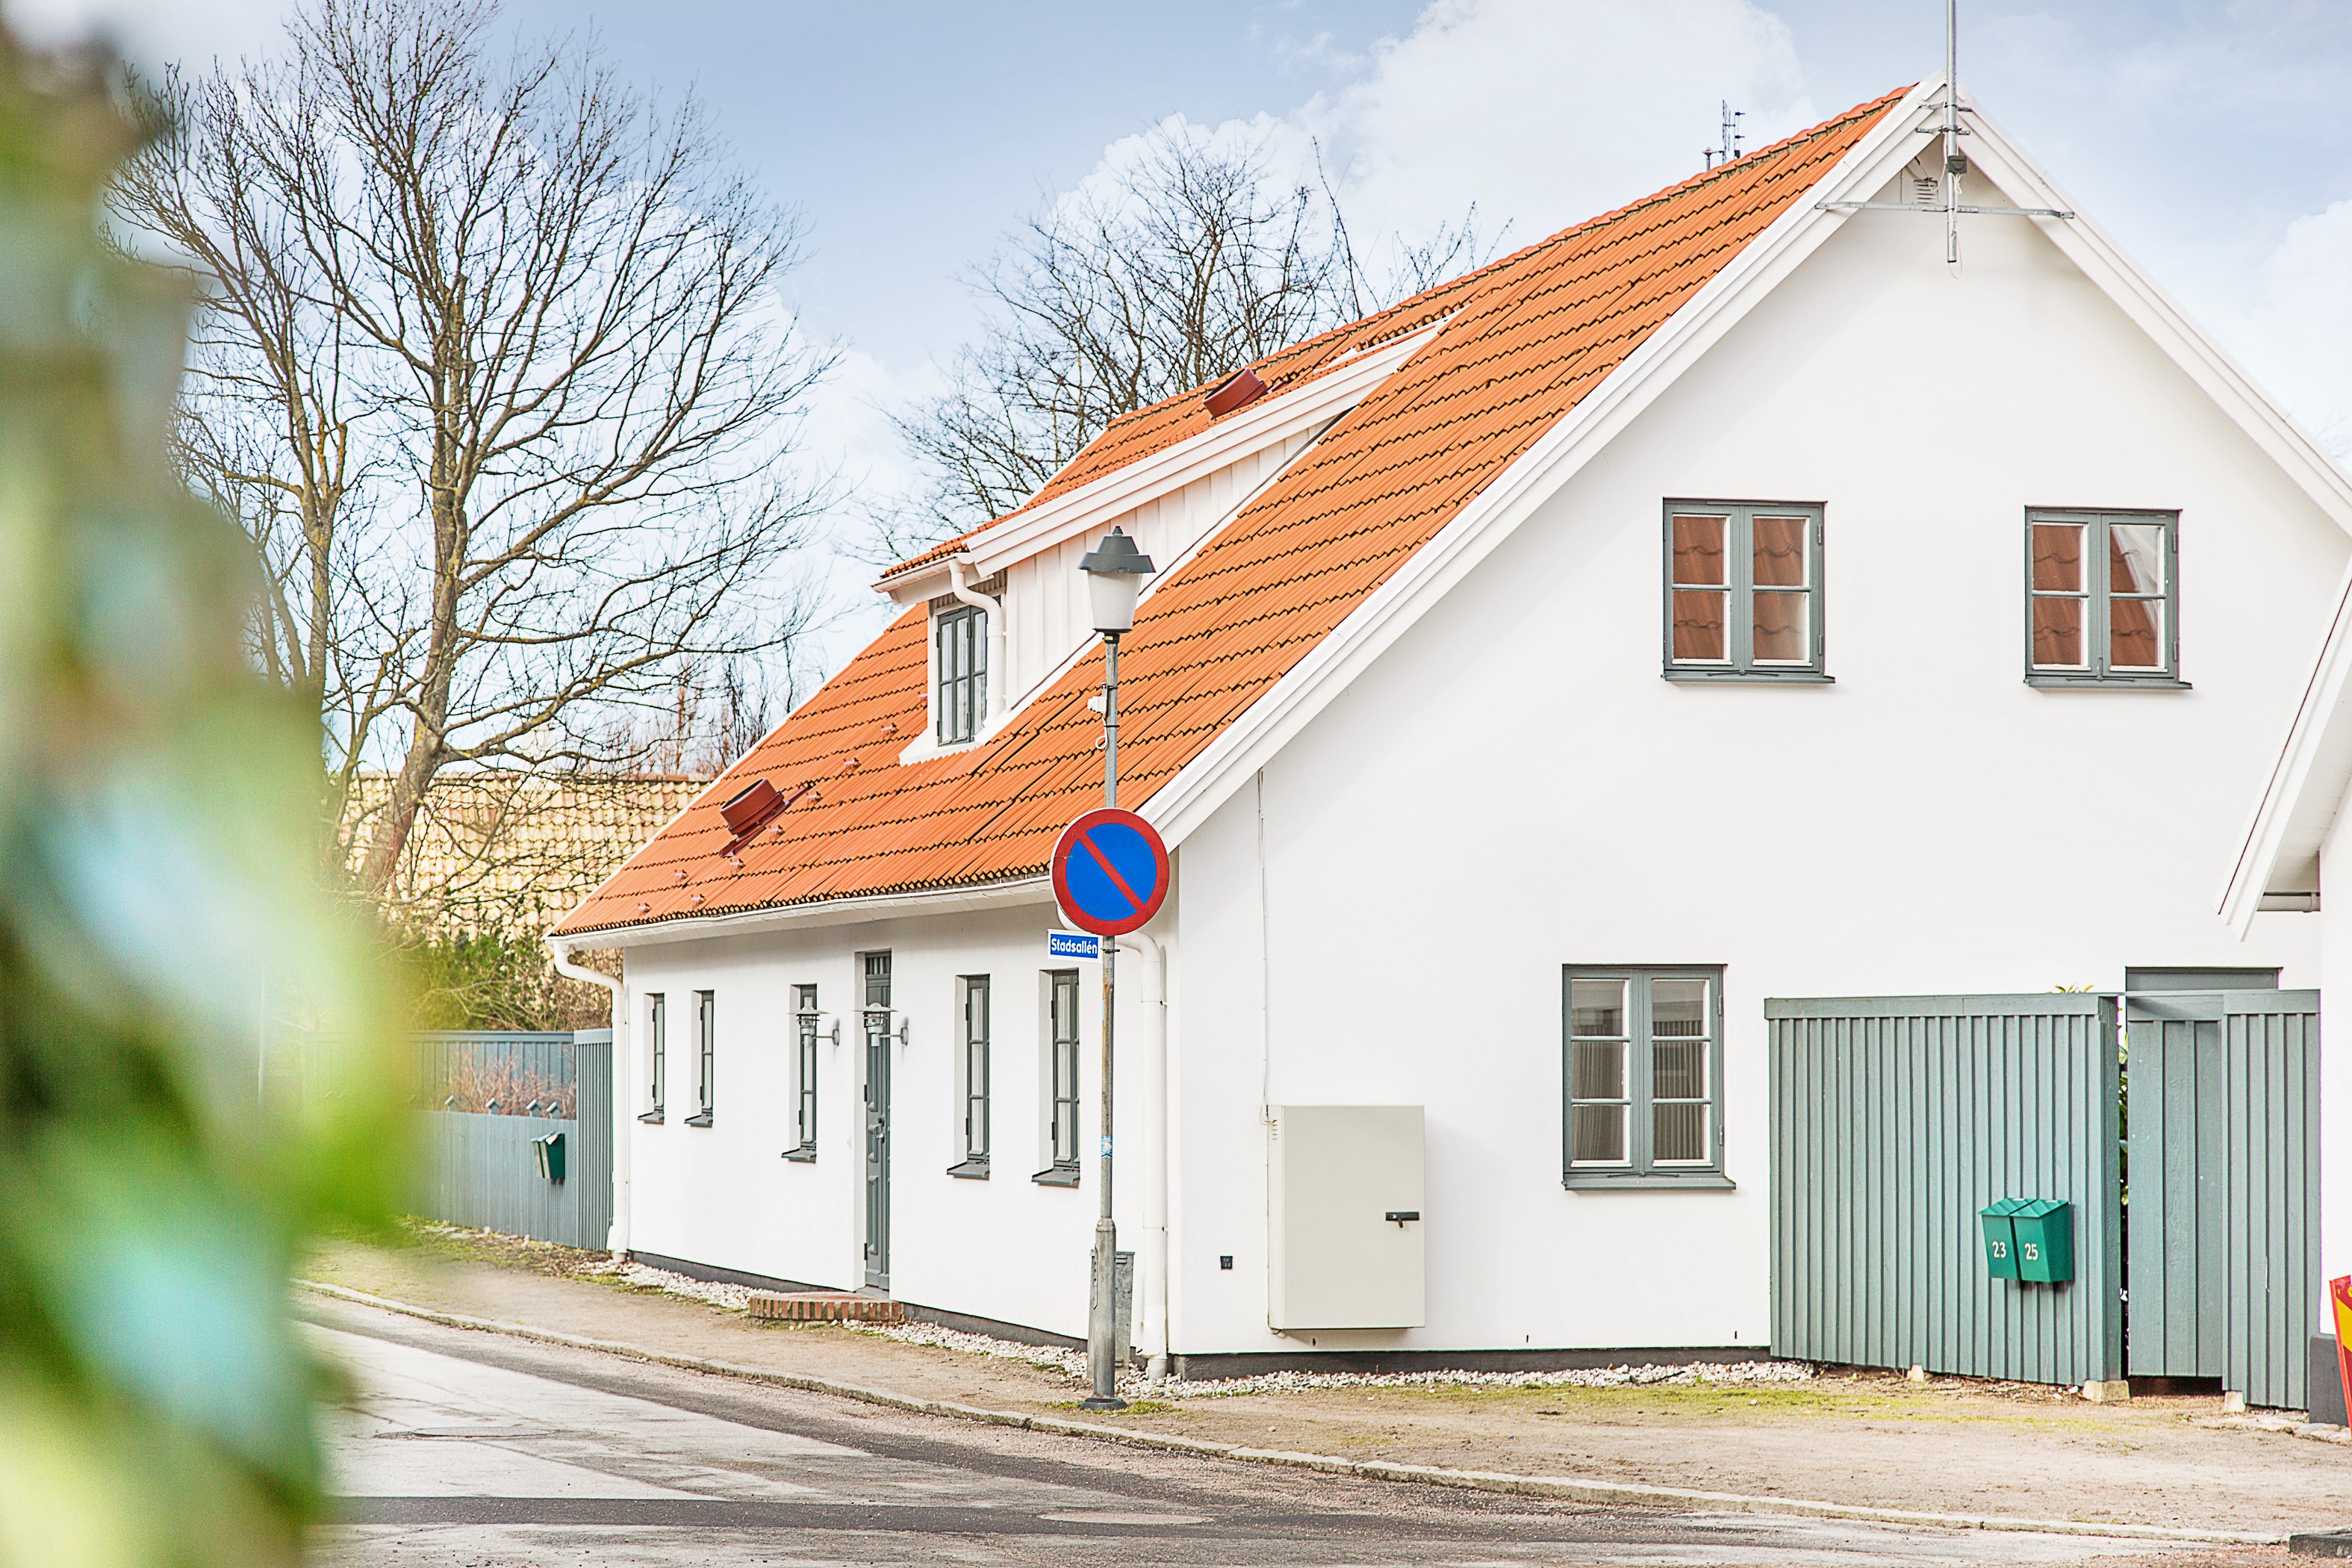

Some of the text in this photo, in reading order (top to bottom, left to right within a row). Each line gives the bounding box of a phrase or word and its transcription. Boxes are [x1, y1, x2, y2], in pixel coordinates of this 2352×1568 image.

[1051, 938, 1097, 953] Stadsallén
[1992, 1241, 2006, 1258] 23
[2024, 1242, 2038, 1260] 25
